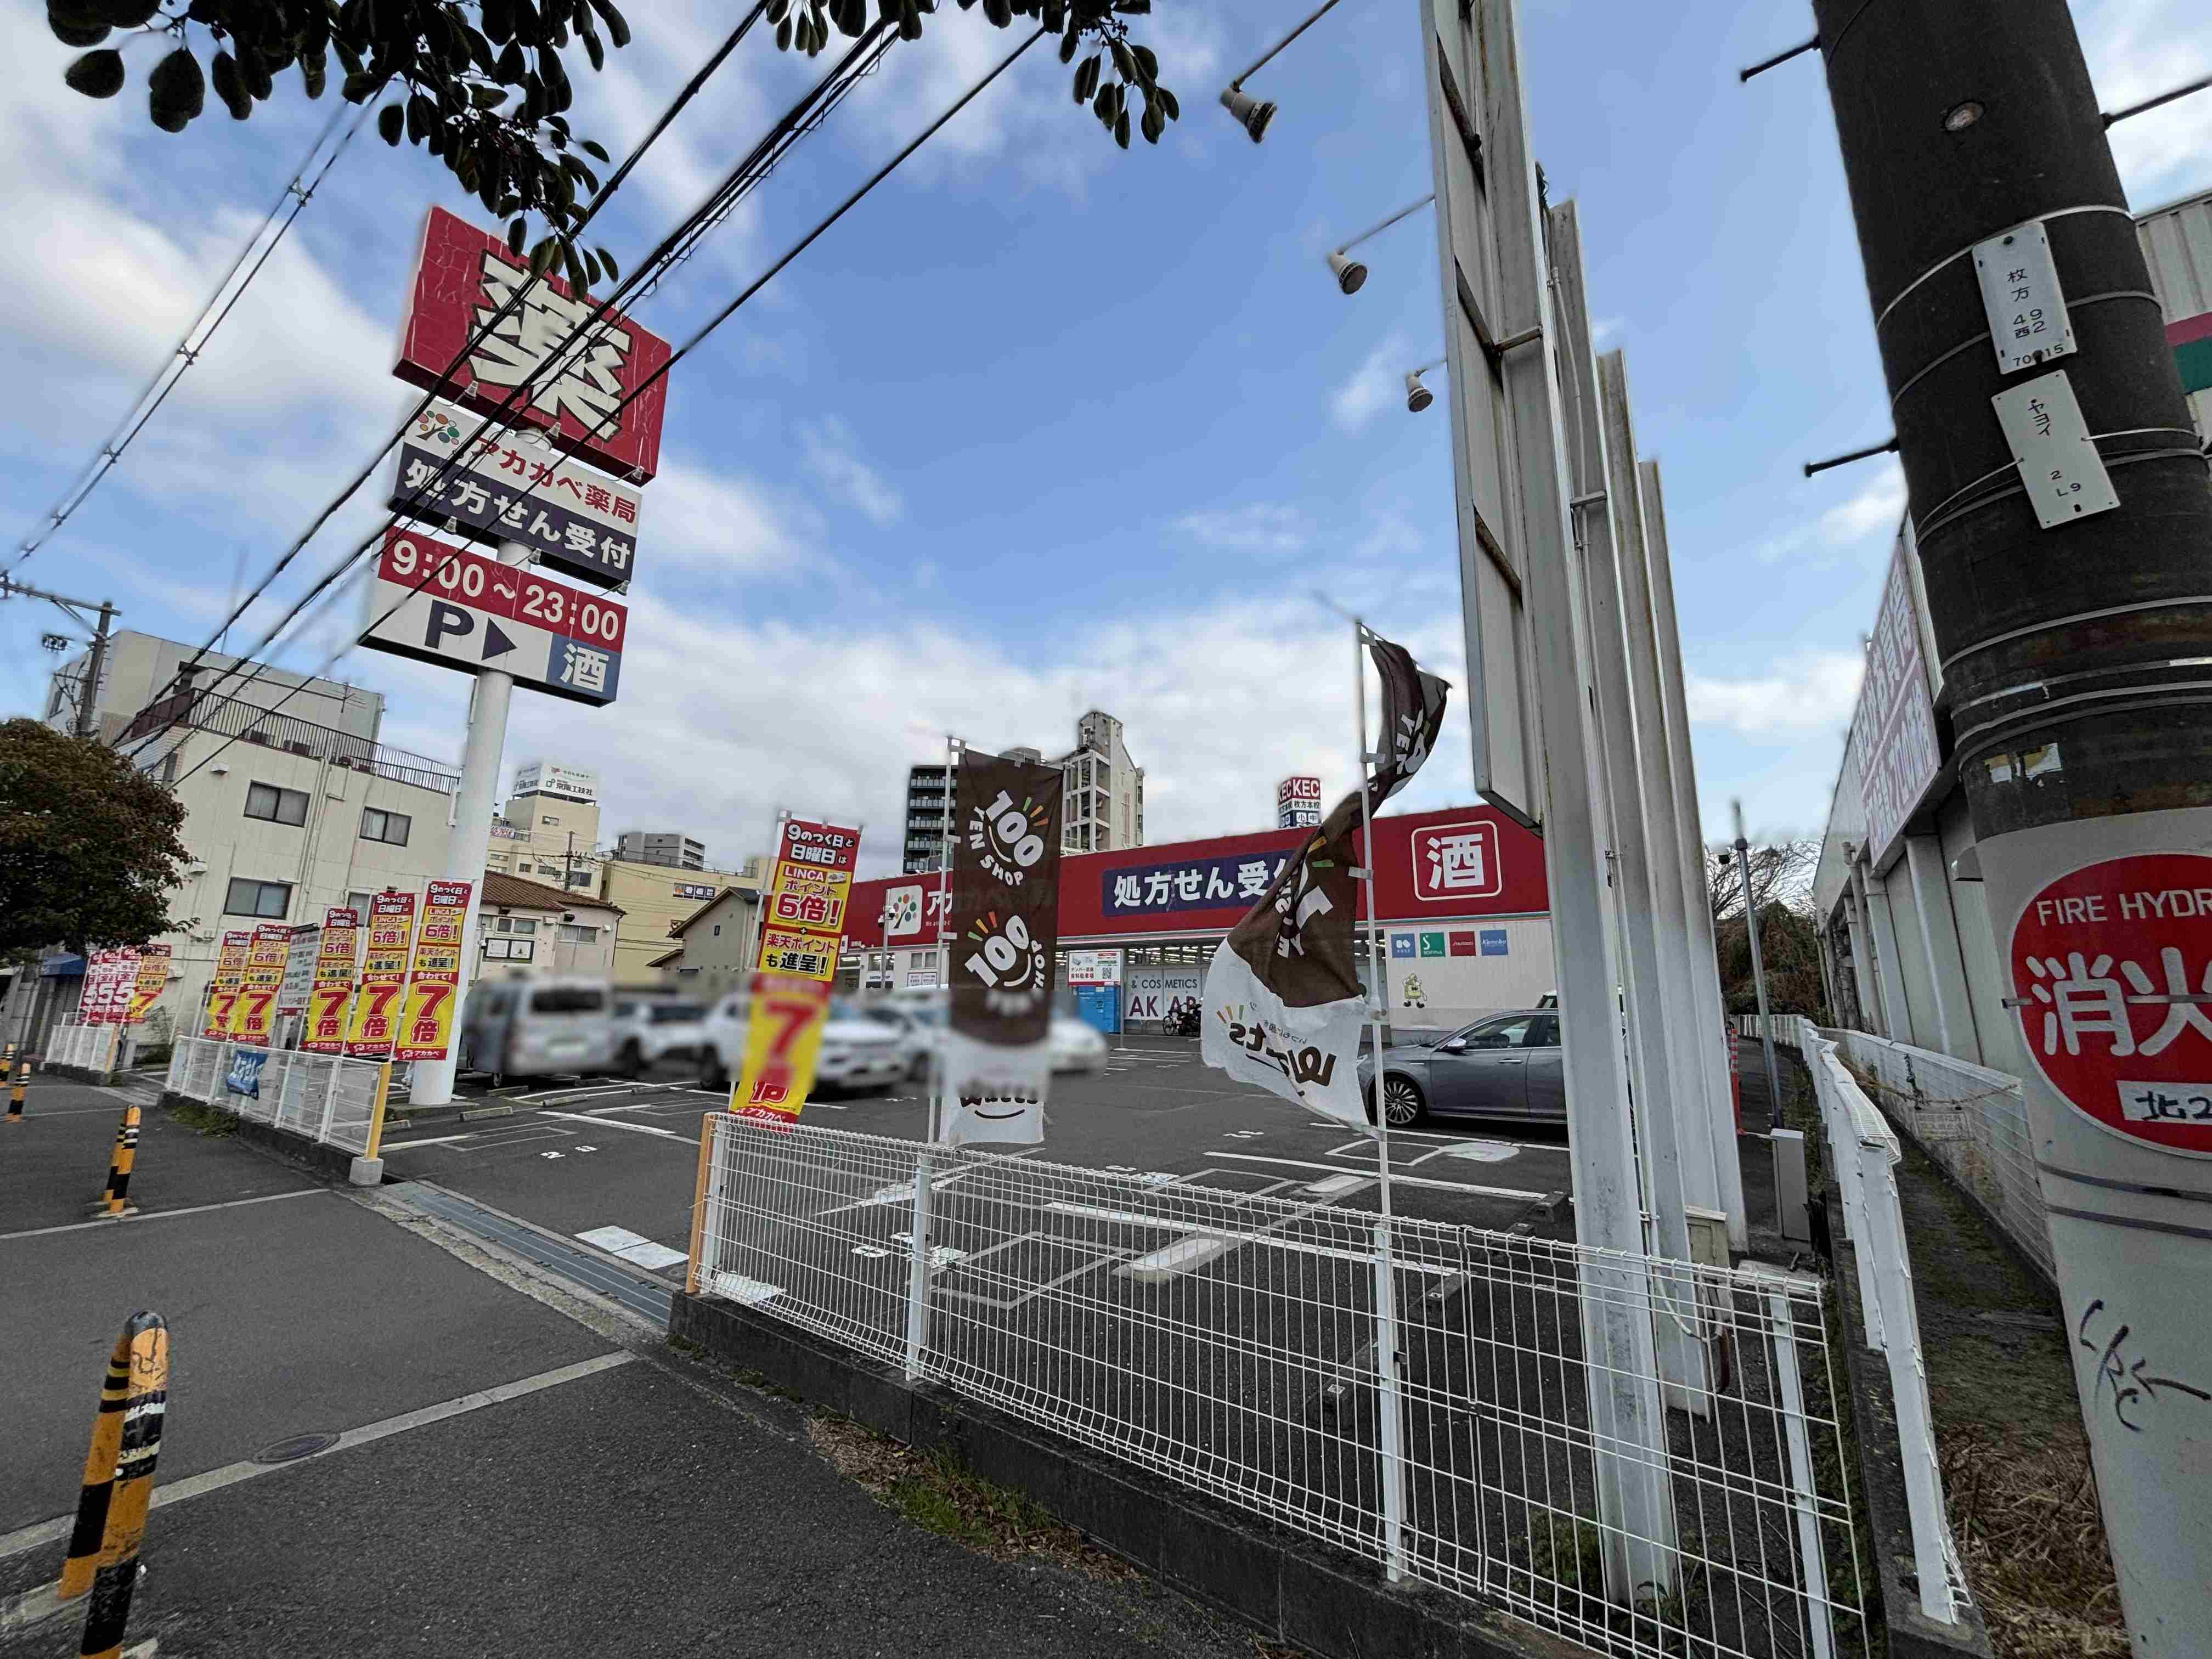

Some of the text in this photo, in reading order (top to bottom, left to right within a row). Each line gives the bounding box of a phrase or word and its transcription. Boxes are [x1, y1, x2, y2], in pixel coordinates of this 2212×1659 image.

[2007, 268, 2031, 302] 枚方
[470, 250, 631, 442] 薬
[471, 438, 637, 524] アカカベ薬局
[404, 459, 631, 569] 処方せん受付
[425, 599, 475, 650] P
[560, 642, 610, 690] 酒
[1293, 778, 1319, 797] KEC
[787, 823, 855, 848] 9のつく日と
[985, 790, 1044, 867] 100
[790, 843, 848, 866] 日曜日は
[969, 806, 1024, 887] YEN SHOP
[1426, 832, 1485, 890] 酒
[430, 884, 468, 894] 9のつく日と
[784, 865, 824, 882] LINCA
[785, 879, 838, 897] ポイント
[1114, 858, 1287, 909] 処方せん受
[432, 895, 464, 905] 日曜日は
[776, 891, 843, 927] 6倍!
[2036, 895, 2108, 927] FIRE
[373, 930, 407, 944] 6倍!
[425, 924, 459, 939] 6倍!
[765, 932, 836, 955] 楽天ポイント
[419, 957, 454, 968] も進呈!
[766, 951, 829, 975] も進呈!
[964, 915, 1030, 988] 100
[1131, 980, 1137, 989] &
[2135, 1090, 2212, 1121] 北2
